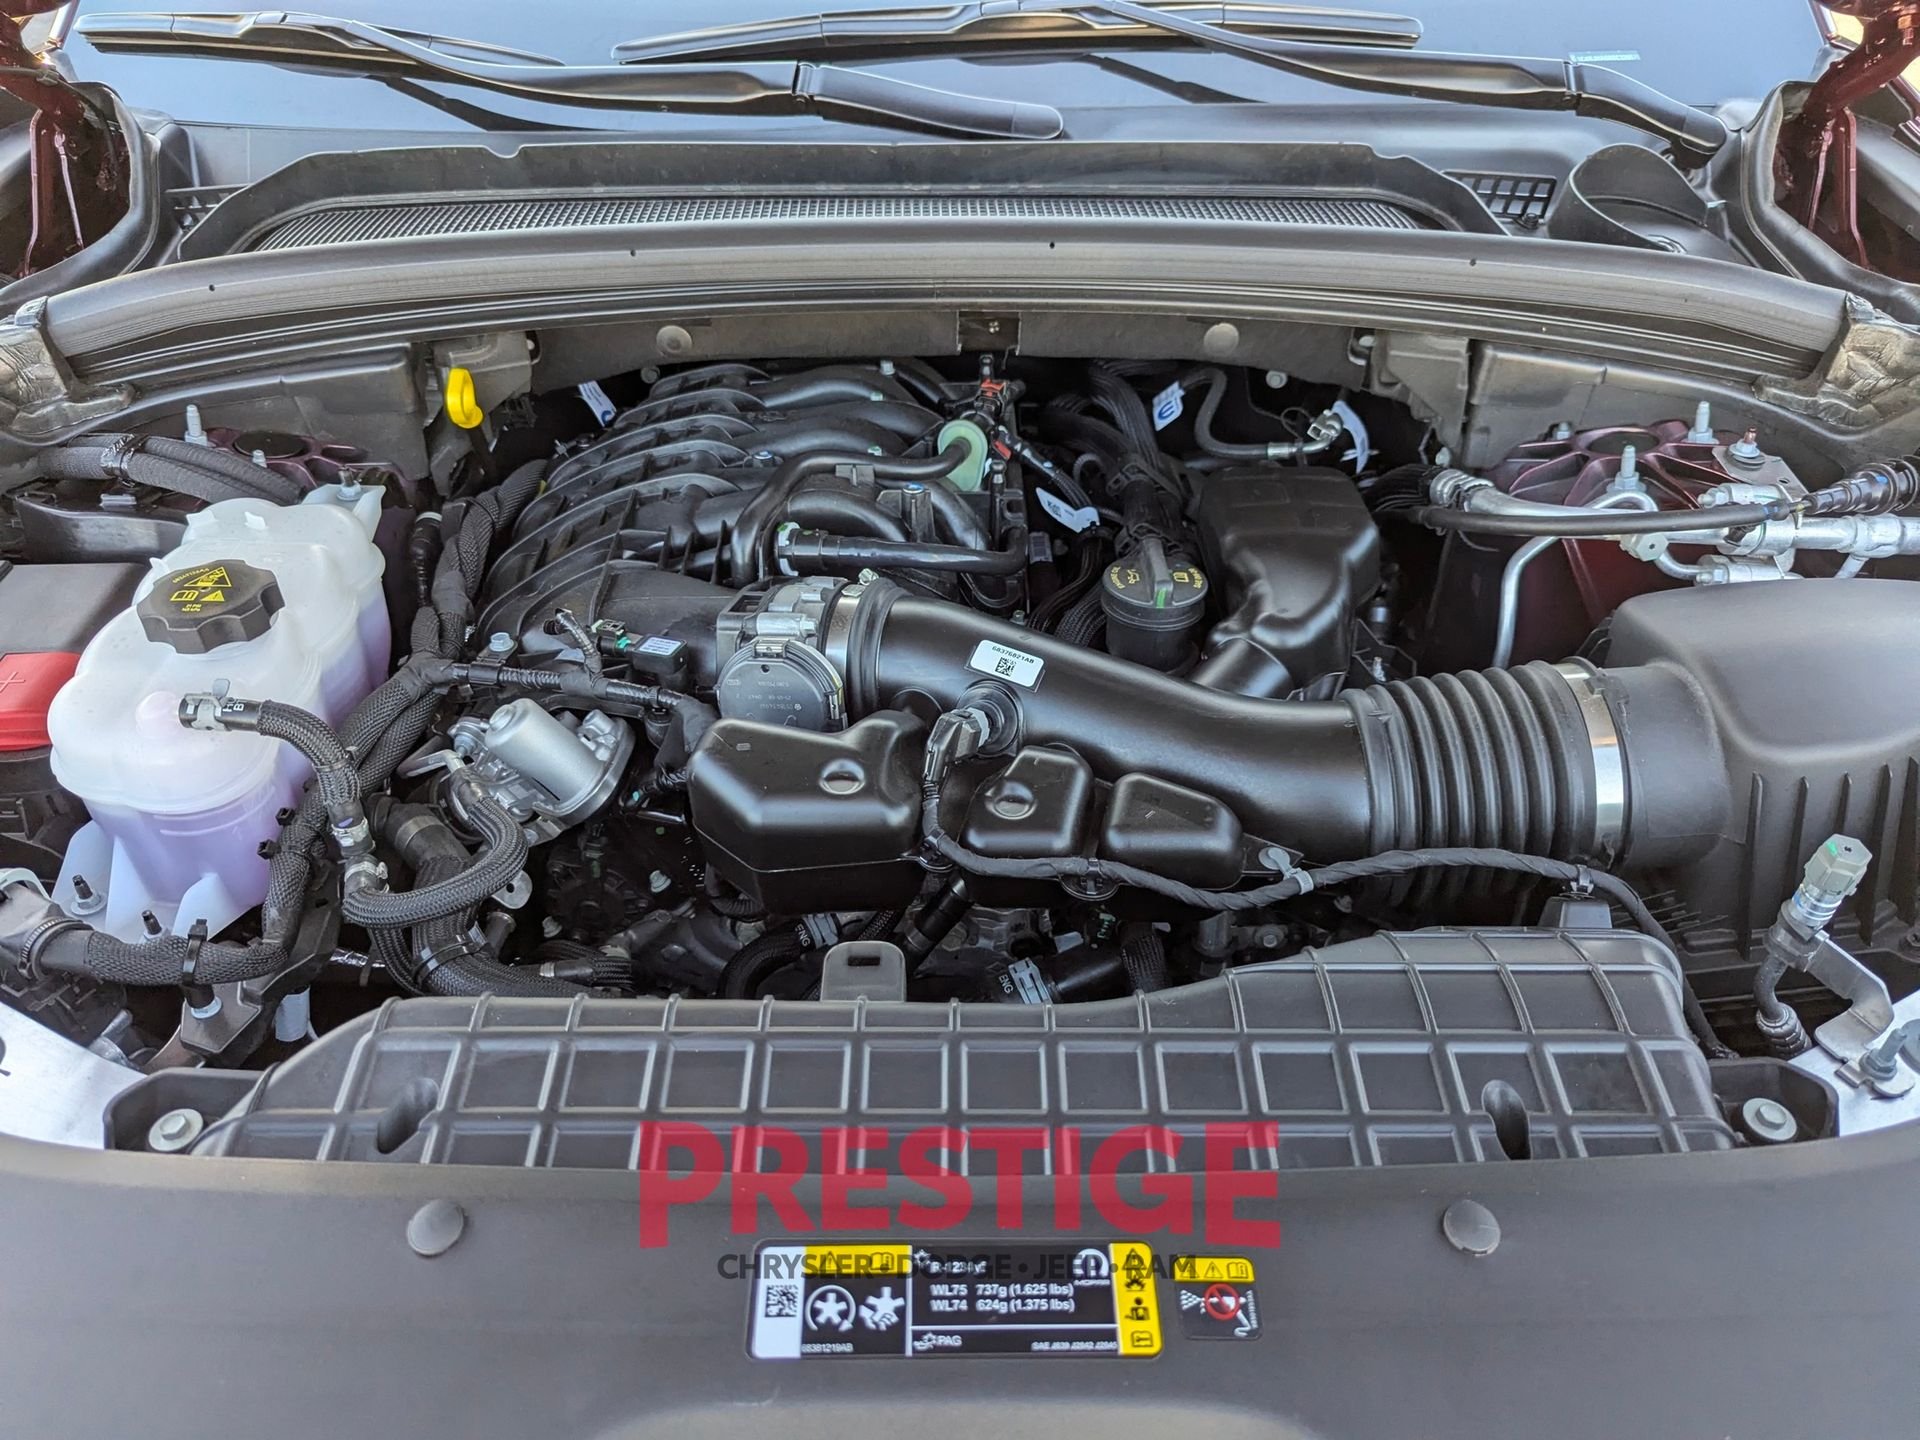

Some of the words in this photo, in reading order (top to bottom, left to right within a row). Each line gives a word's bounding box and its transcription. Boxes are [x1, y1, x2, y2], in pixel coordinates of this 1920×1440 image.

[795, 924, 811, 947] ENG
[999, 974, 1014, 994] ENG
[930, 1284, 968, 1296] WL75
[975, 1284, 1008, 1298] 737g
[1009, 1283, 1048, 1297] (1.625
[1049, 1283, 1074, 1297] lbs)
[930, 1299, 968, 1312] WL74
[975, 1299, 1009, 1314] 624g
[1009, 1299, 1049, 1313] (1.375
[1050, 1299, 1076, 1313] lbs)
[937, 1336, 962, 1346] PAG
